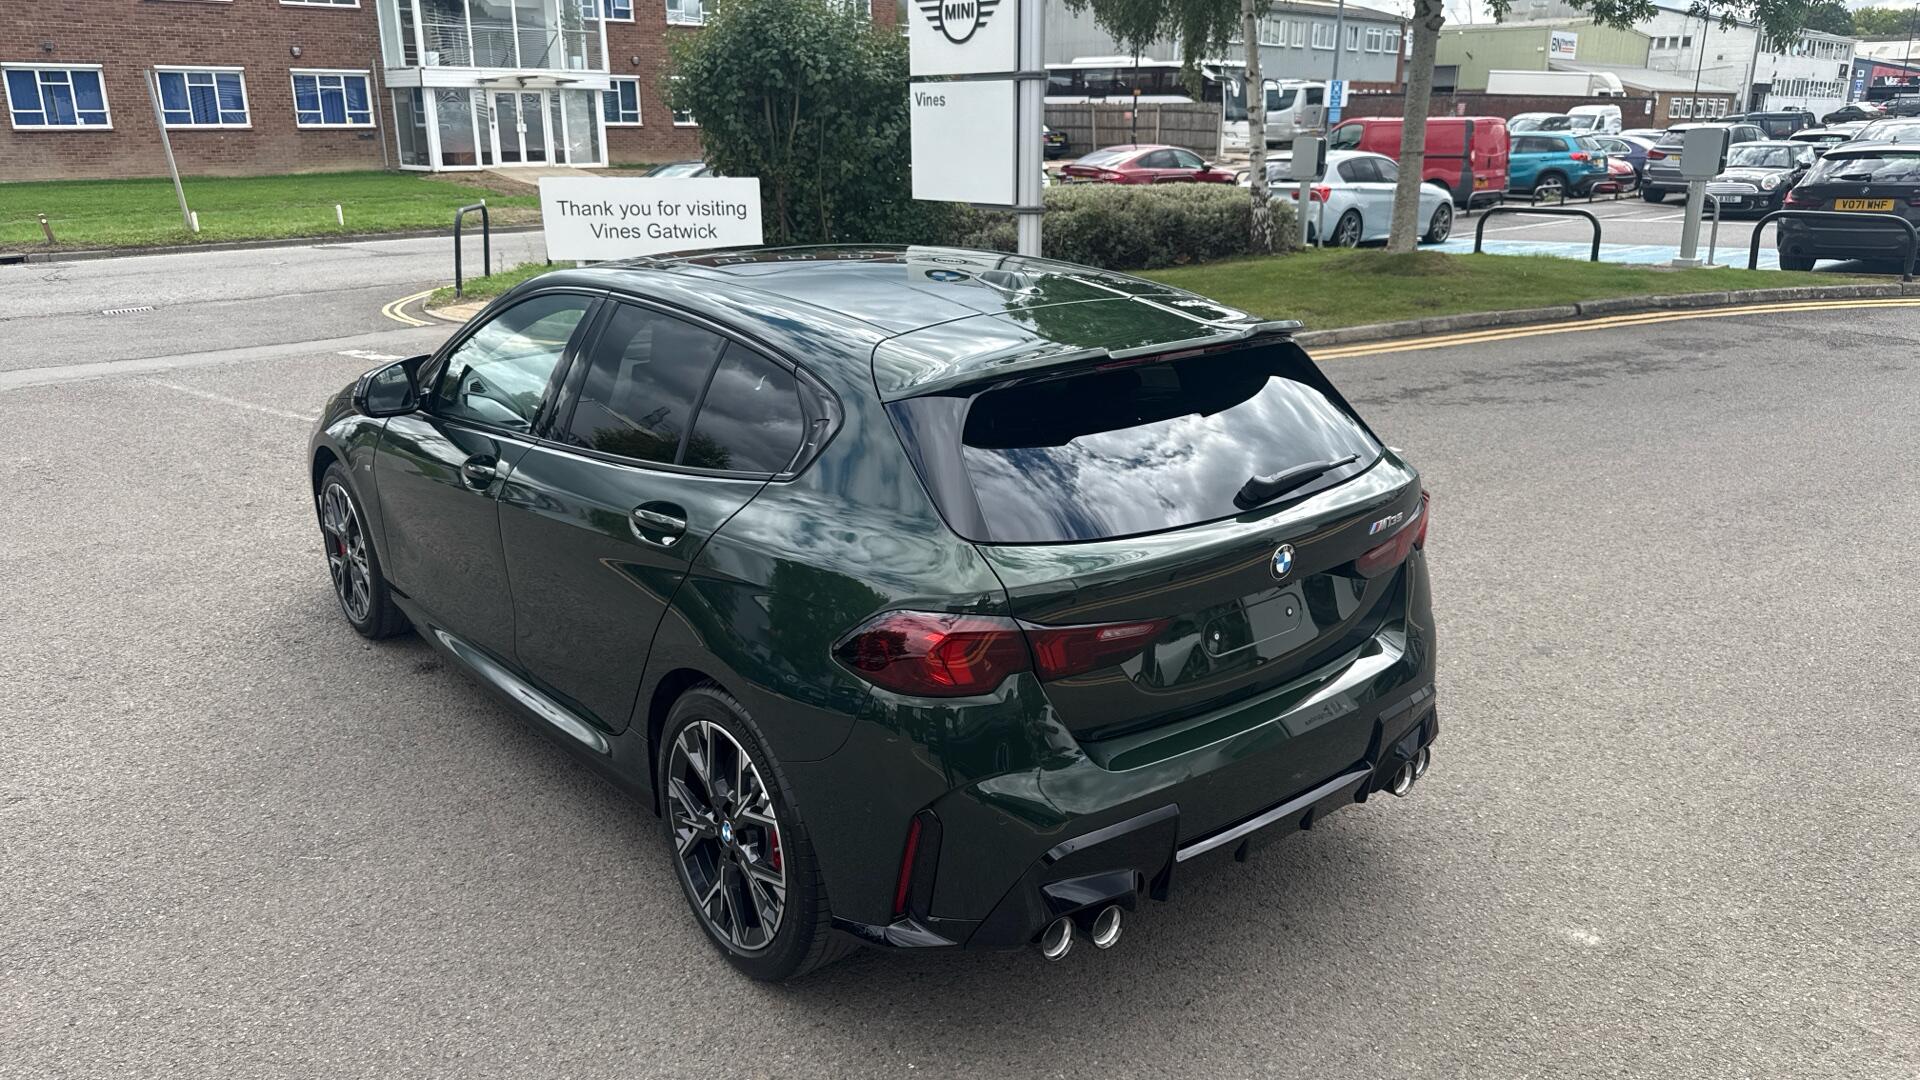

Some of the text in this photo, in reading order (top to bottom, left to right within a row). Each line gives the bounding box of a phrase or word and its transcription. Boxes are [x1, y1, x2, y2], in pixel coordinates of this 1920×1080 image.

[945, 2, 975, 20] MINI
[915, 92, 946, 107] Vines
[556, 200, 748, 220] Thank you for visiting
[1867, 200, 1889, 210] WHF
[590, 223, 718, 239] Vines Gatwick
